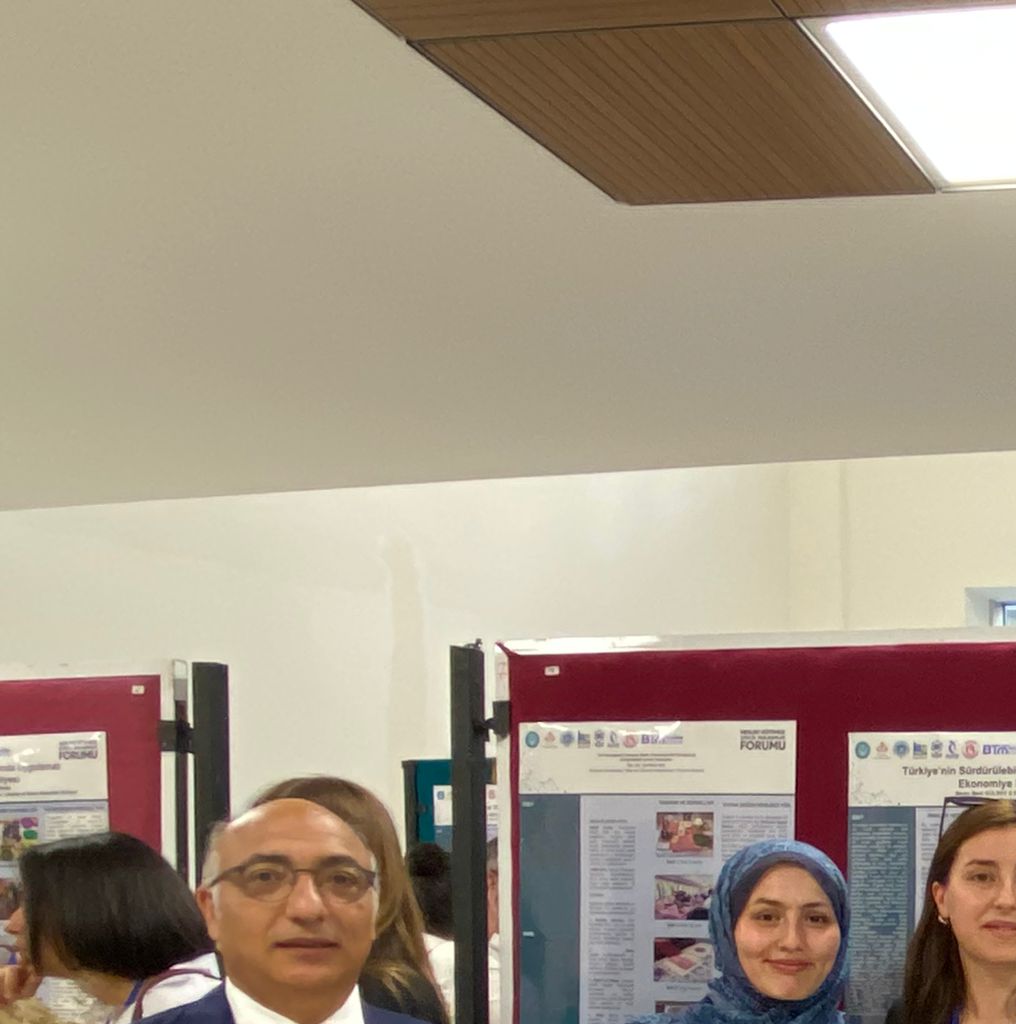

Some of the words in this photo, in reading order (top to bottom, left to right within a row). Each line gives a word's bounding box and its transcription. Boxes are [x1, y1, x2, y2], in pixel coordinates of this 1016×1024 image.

[740, 740, 786, 750] FORUMU
[902, 766, 957, 777] Türkiye'nin
[958, 779, 1012, 790] Ekonomiye
